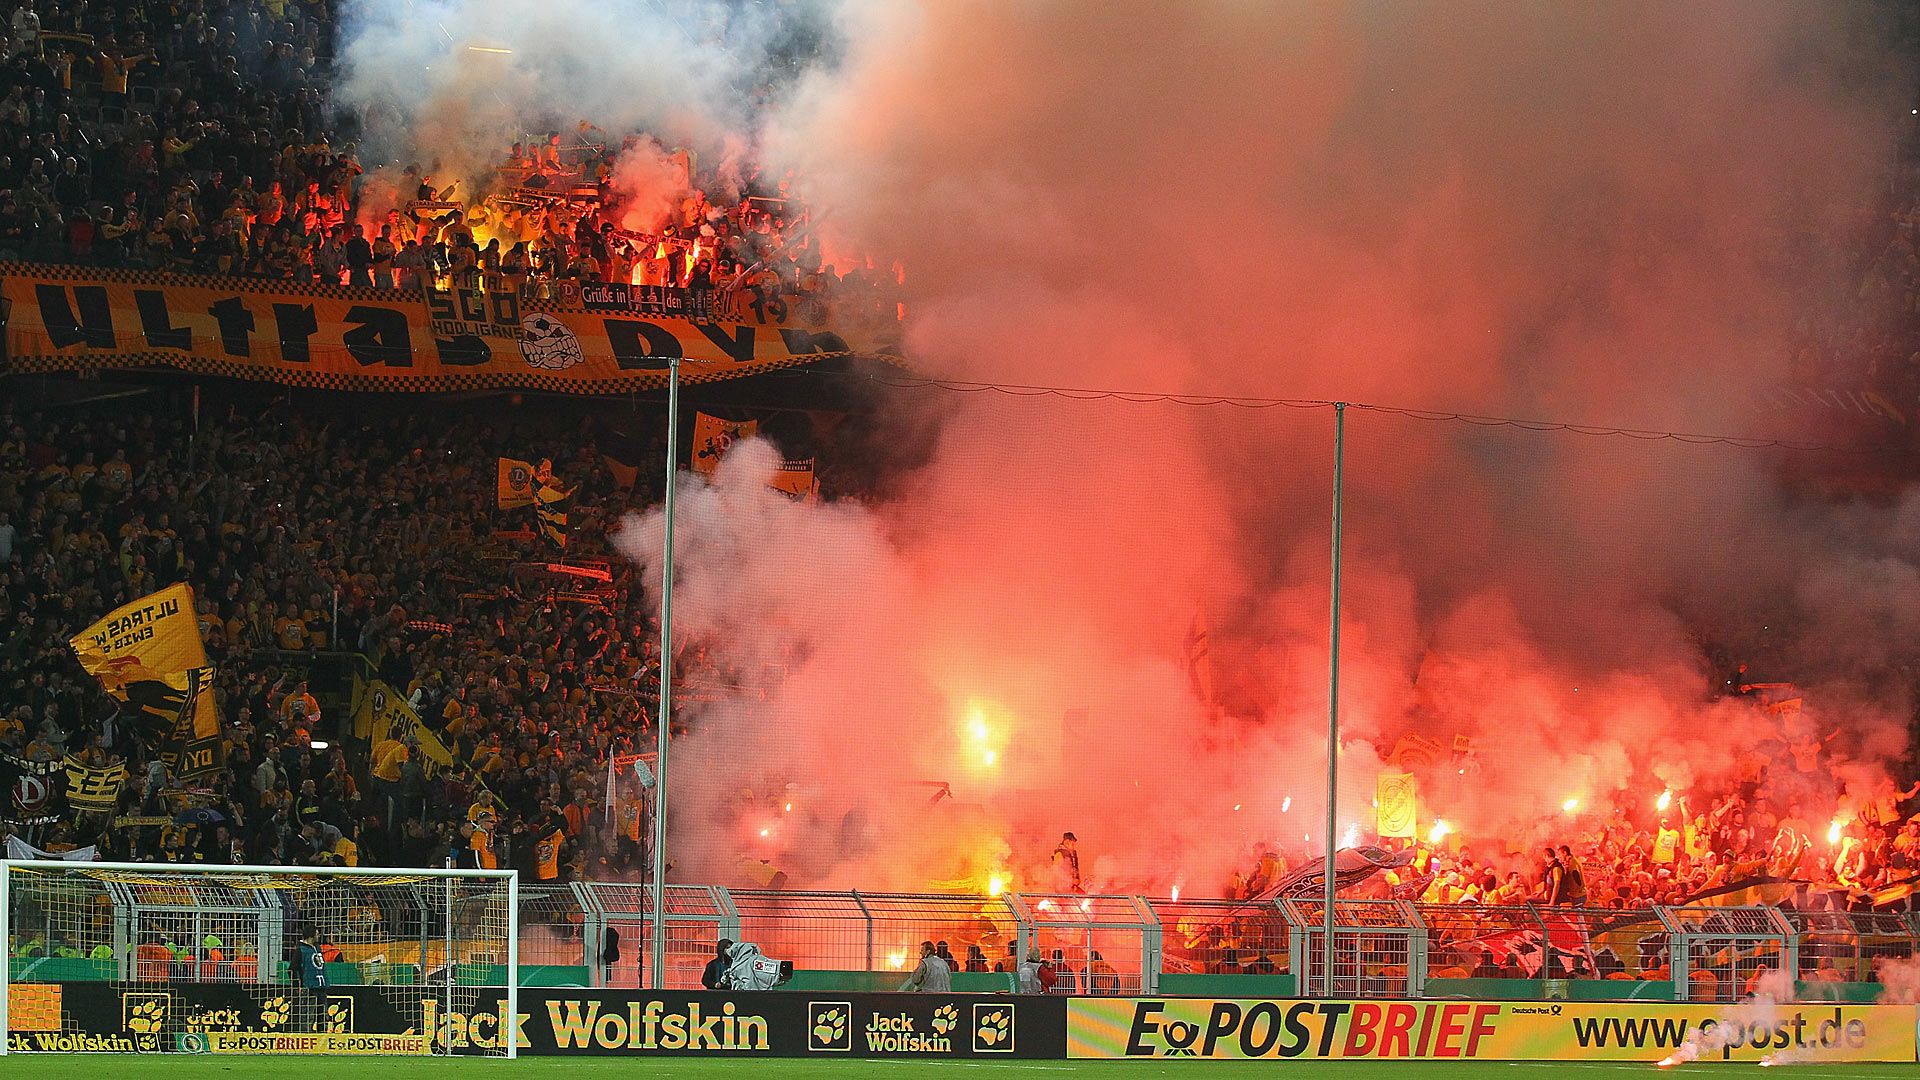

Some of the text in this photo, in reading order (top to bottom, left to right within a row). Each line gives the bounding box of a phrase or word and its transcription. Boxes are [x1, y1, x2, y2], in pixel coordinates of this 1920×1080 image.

[582, 286, 614, 304] Grüße
[616, 289, 627, 304] in
[666, 293, 682, 309] den
[432, 320, 526, 340] HOOLIGANS
[401, 999, 770, 1050] Jack Wolfskin
[865, 1012, 914, 1032] Jack
[35, 1033, 134, 1051] Wolfskin
[865, 1032, 951, 1052] Wolfskin
